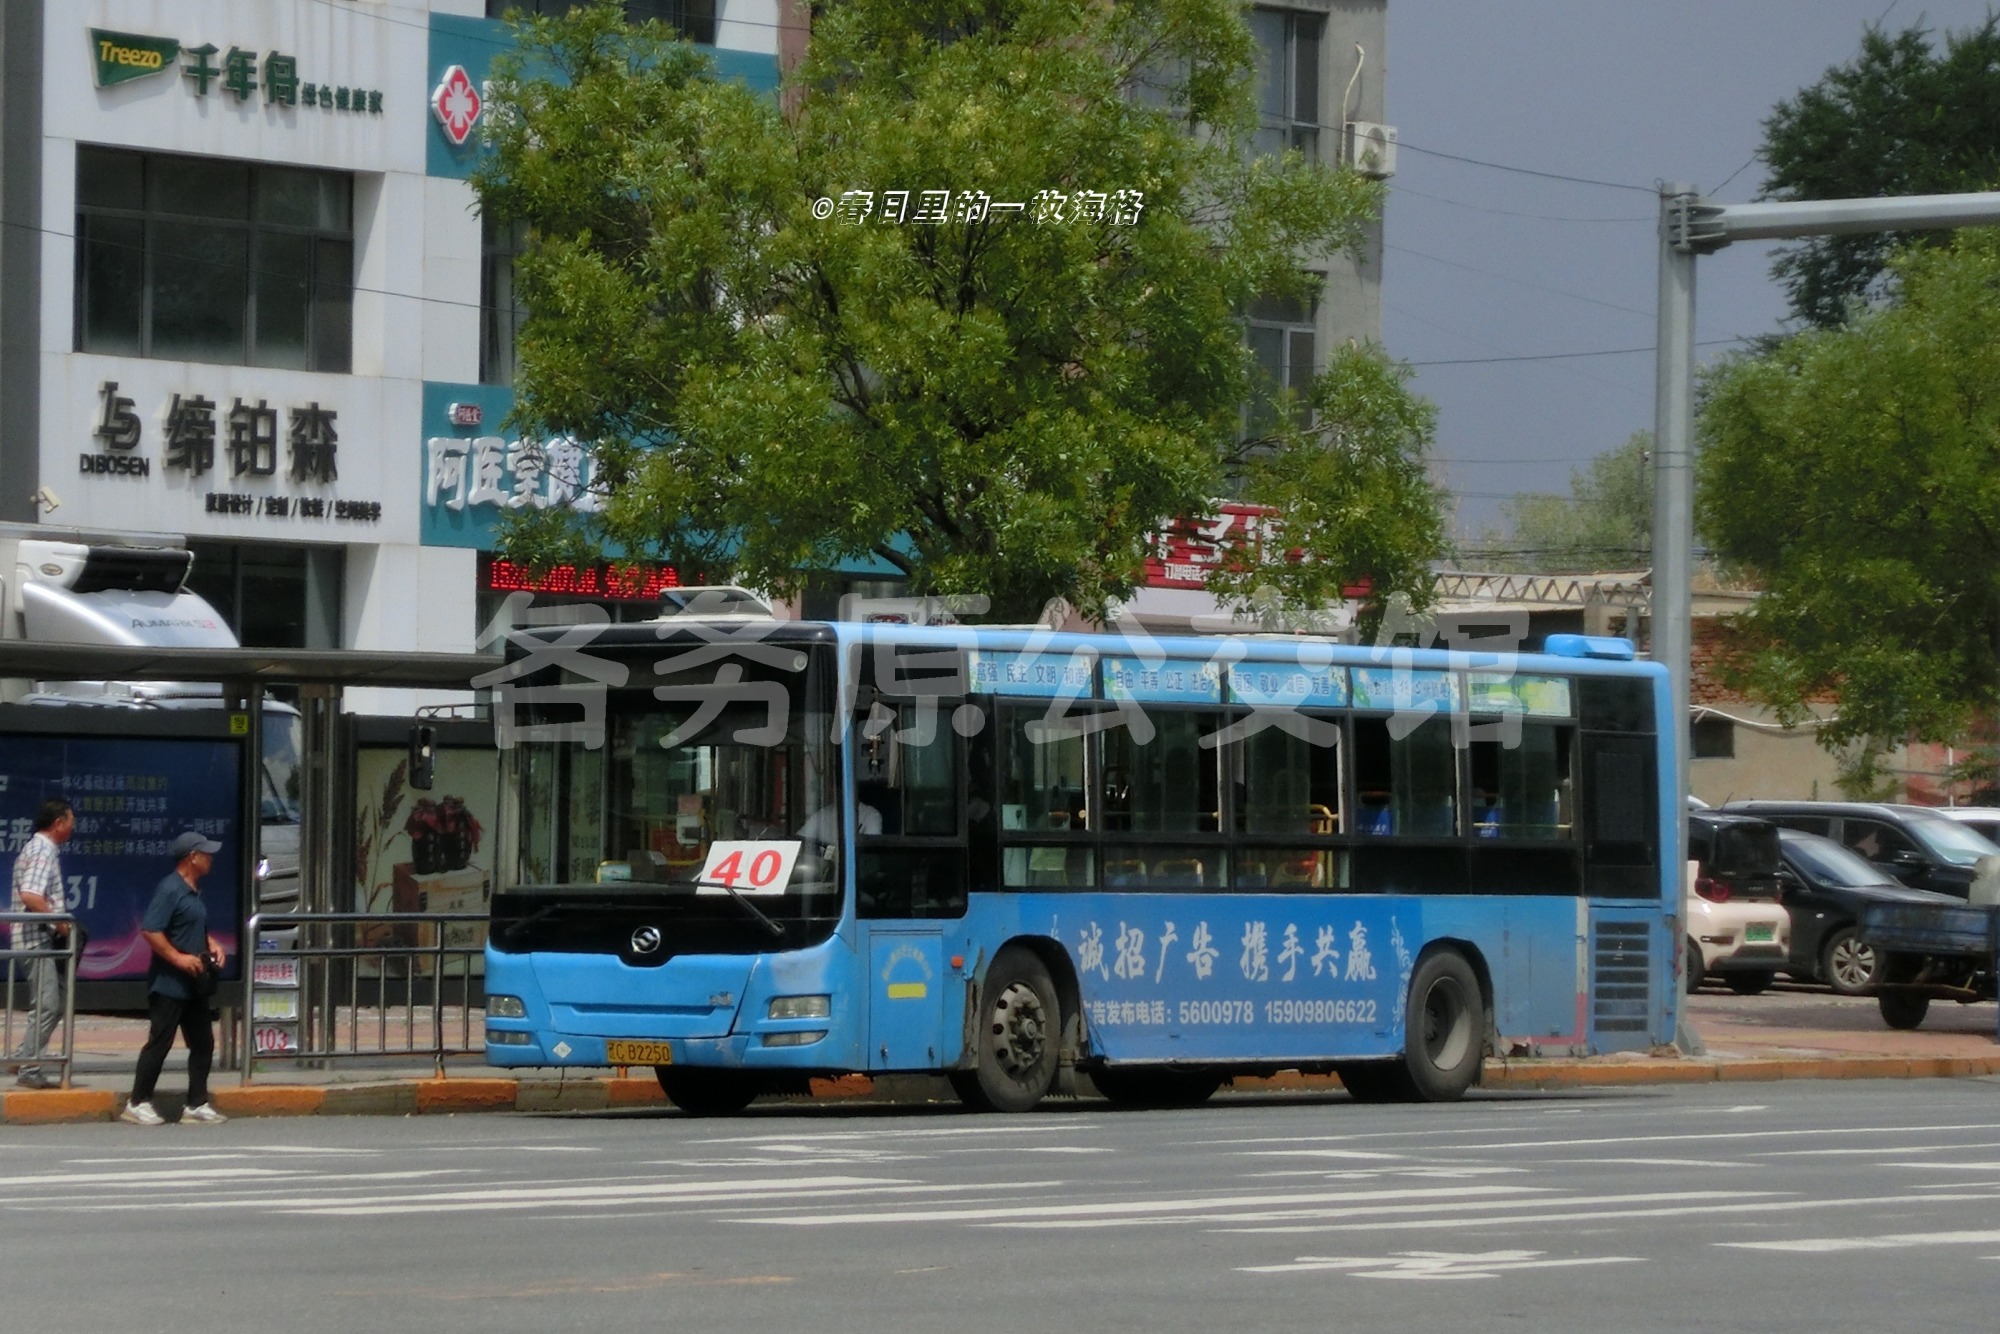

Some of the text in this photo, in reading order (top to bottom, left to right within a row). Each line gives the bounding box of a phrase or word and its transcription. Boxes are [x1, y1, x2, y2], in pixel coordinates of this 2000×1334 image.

[100, 41, 162, 69] Treezo
[180, 43, 299, 106] 千年舟
[162, 393, 338, 482] 缔铂森
[80, 454, 149, 476] DIBOSEN
[977, 662, 998, 683] 富强
[1006, 663, 1028, 684] 民主
[1035, 664, 1057, 685] 文明
[1115, 670, 1134, 690] 自由
[1141, 671, 1159, 691] 平等
[1165, 672, 1184, 692] 公正
[1234, 673, 1253, 693] 爱国
[1311, 676, 1330, 697] 友善
[710, 850, 782, 887] 40
[1078, 920, 1376, 983] 诚招广告 携手共赢
[1179, 1001, 1254, 1024] 5600978
[1265, 999, 1377, 1023] 15909806622
